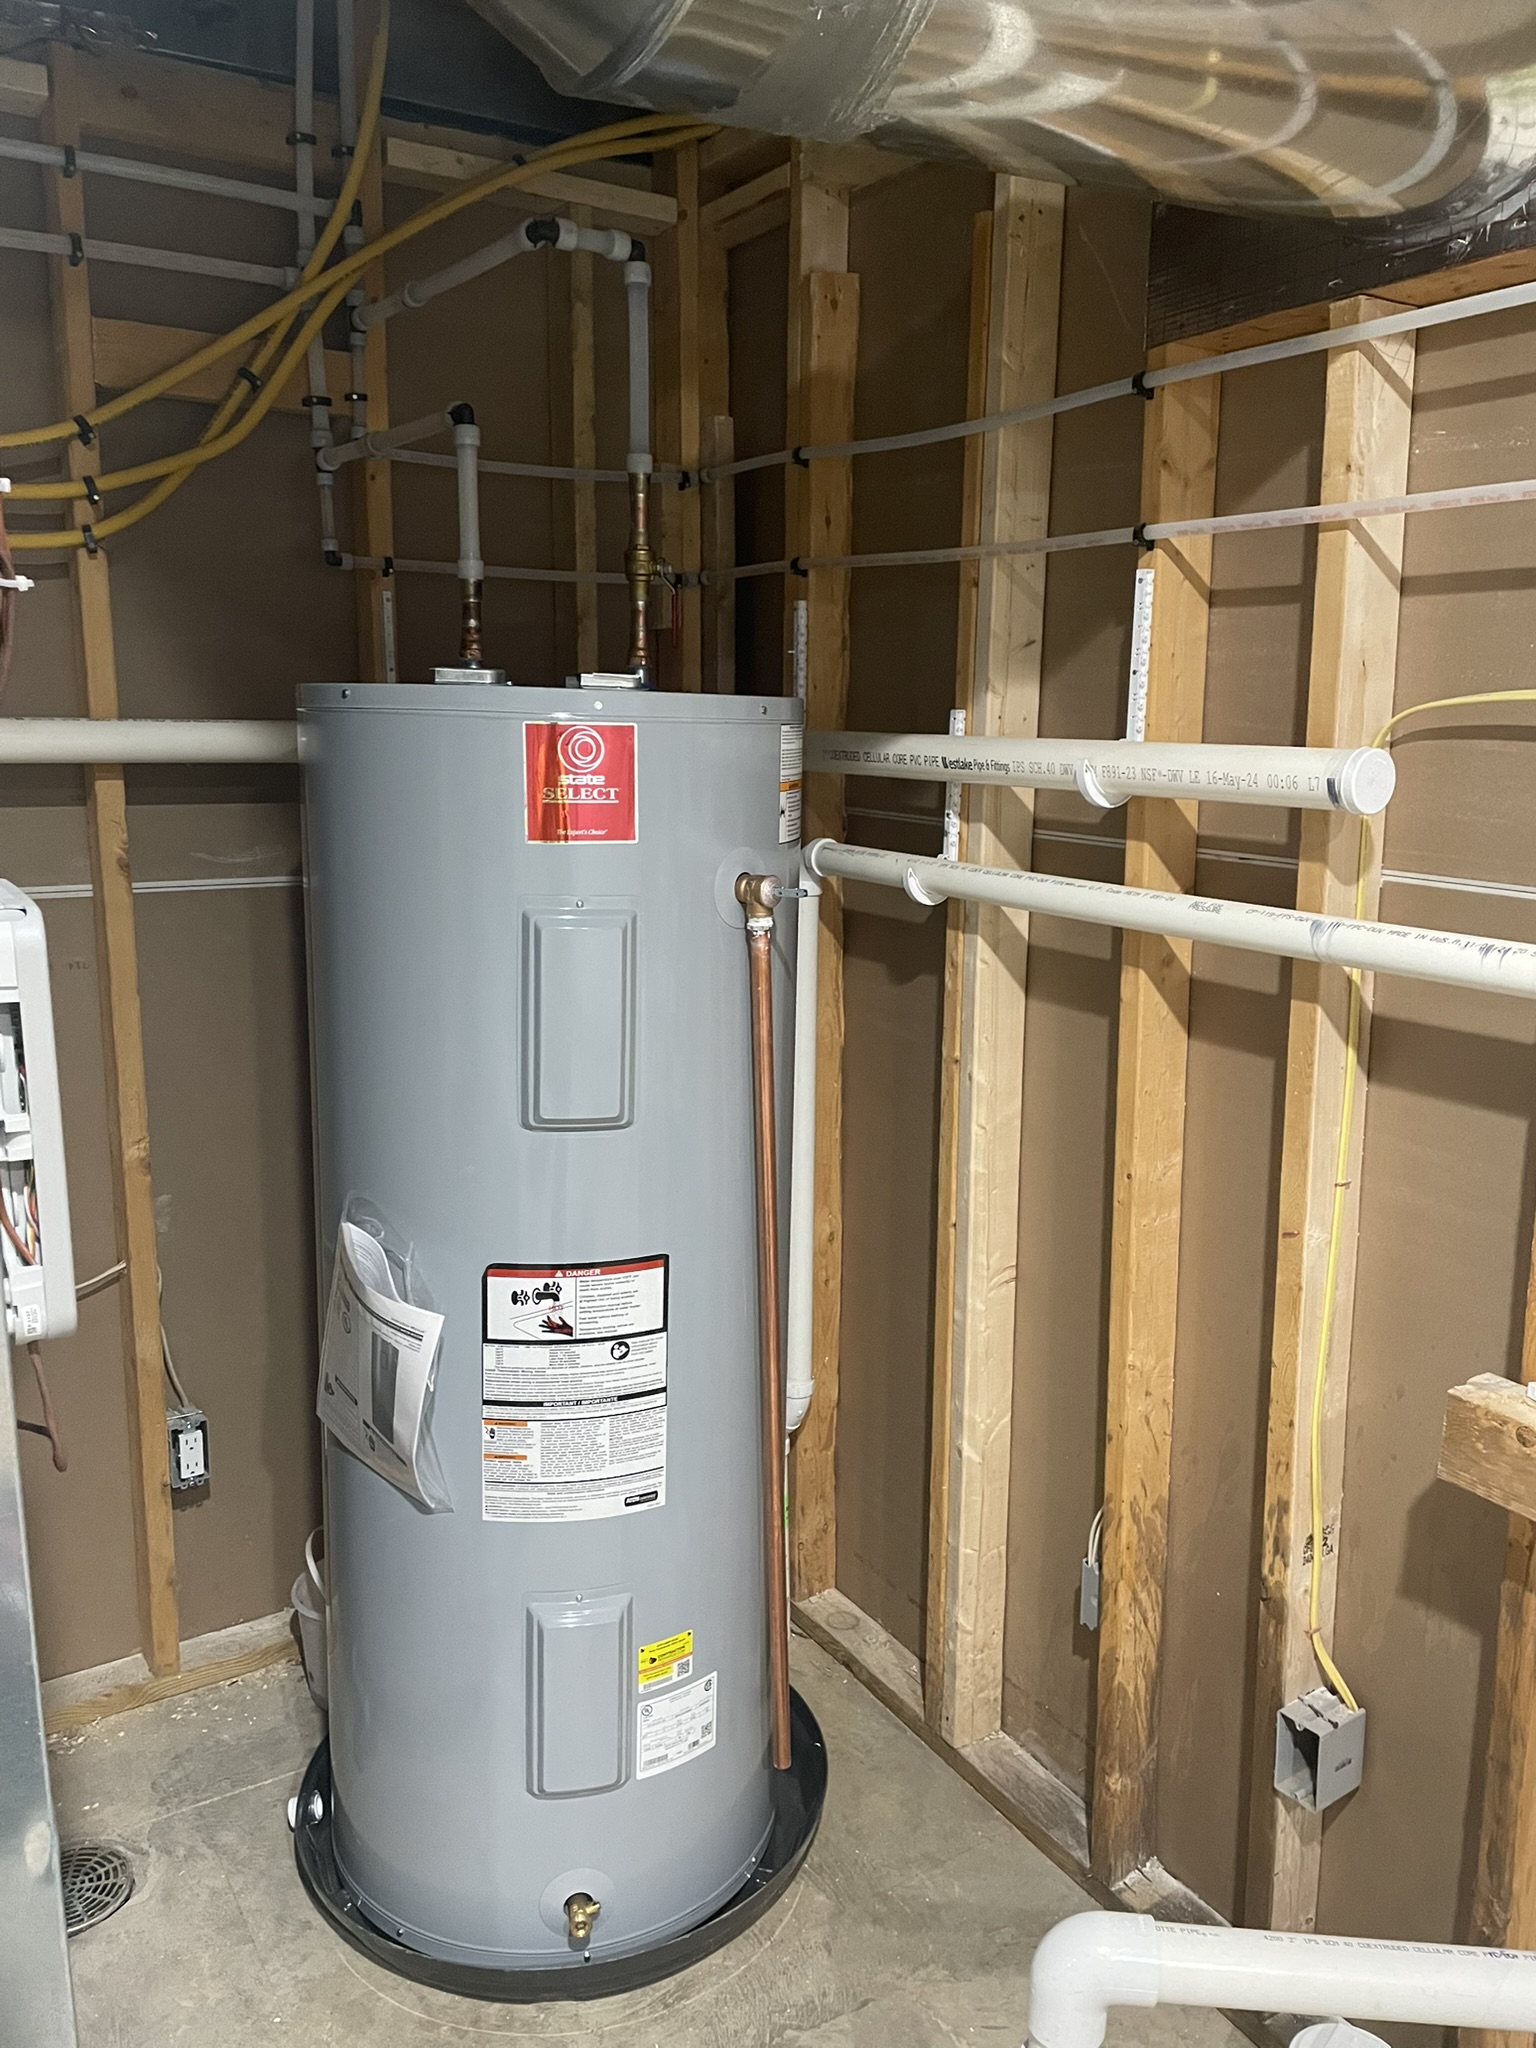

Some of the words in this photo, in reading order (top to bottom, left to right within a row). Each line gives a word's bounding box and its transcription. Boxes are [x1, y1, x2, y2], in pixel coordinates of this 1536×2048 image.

[863, 752, 890, 764] CELLULAR
[893, 754, 908, 766] CORE
[909, 755, 922, 767] PVC
[924, 755, 940, 768] PIPE
[941, 756, 973, 771] Westlake
[973, 759, 985, 773] Pipe
[991, 759, 1011, 775] Fittings
[1012, 761, 1025, 774] IPS
[1029, 762, 1056, 775] SCH.40
[1060, 763, 1074, 776] DWV
[558, 774, 605, 785] state
[1101, 765, 1137, 781] F891-23
[1189, 770, 1201, 784] LE
[1206, 771, 1260, 790] 16-May-24
[1267, 773, 1299, 790] 00:06
[1308, 776, 1321, 792] L7
[542, 787, 619, 800] SELECT
[1387, 930, 1411, 938] MADE
[566, 1269, 601, 1277] DANGER
[1357, 1942, 1410, 1952] COEXTRUDED
[1412, 1946, 1454, 1955] CELLULAR
